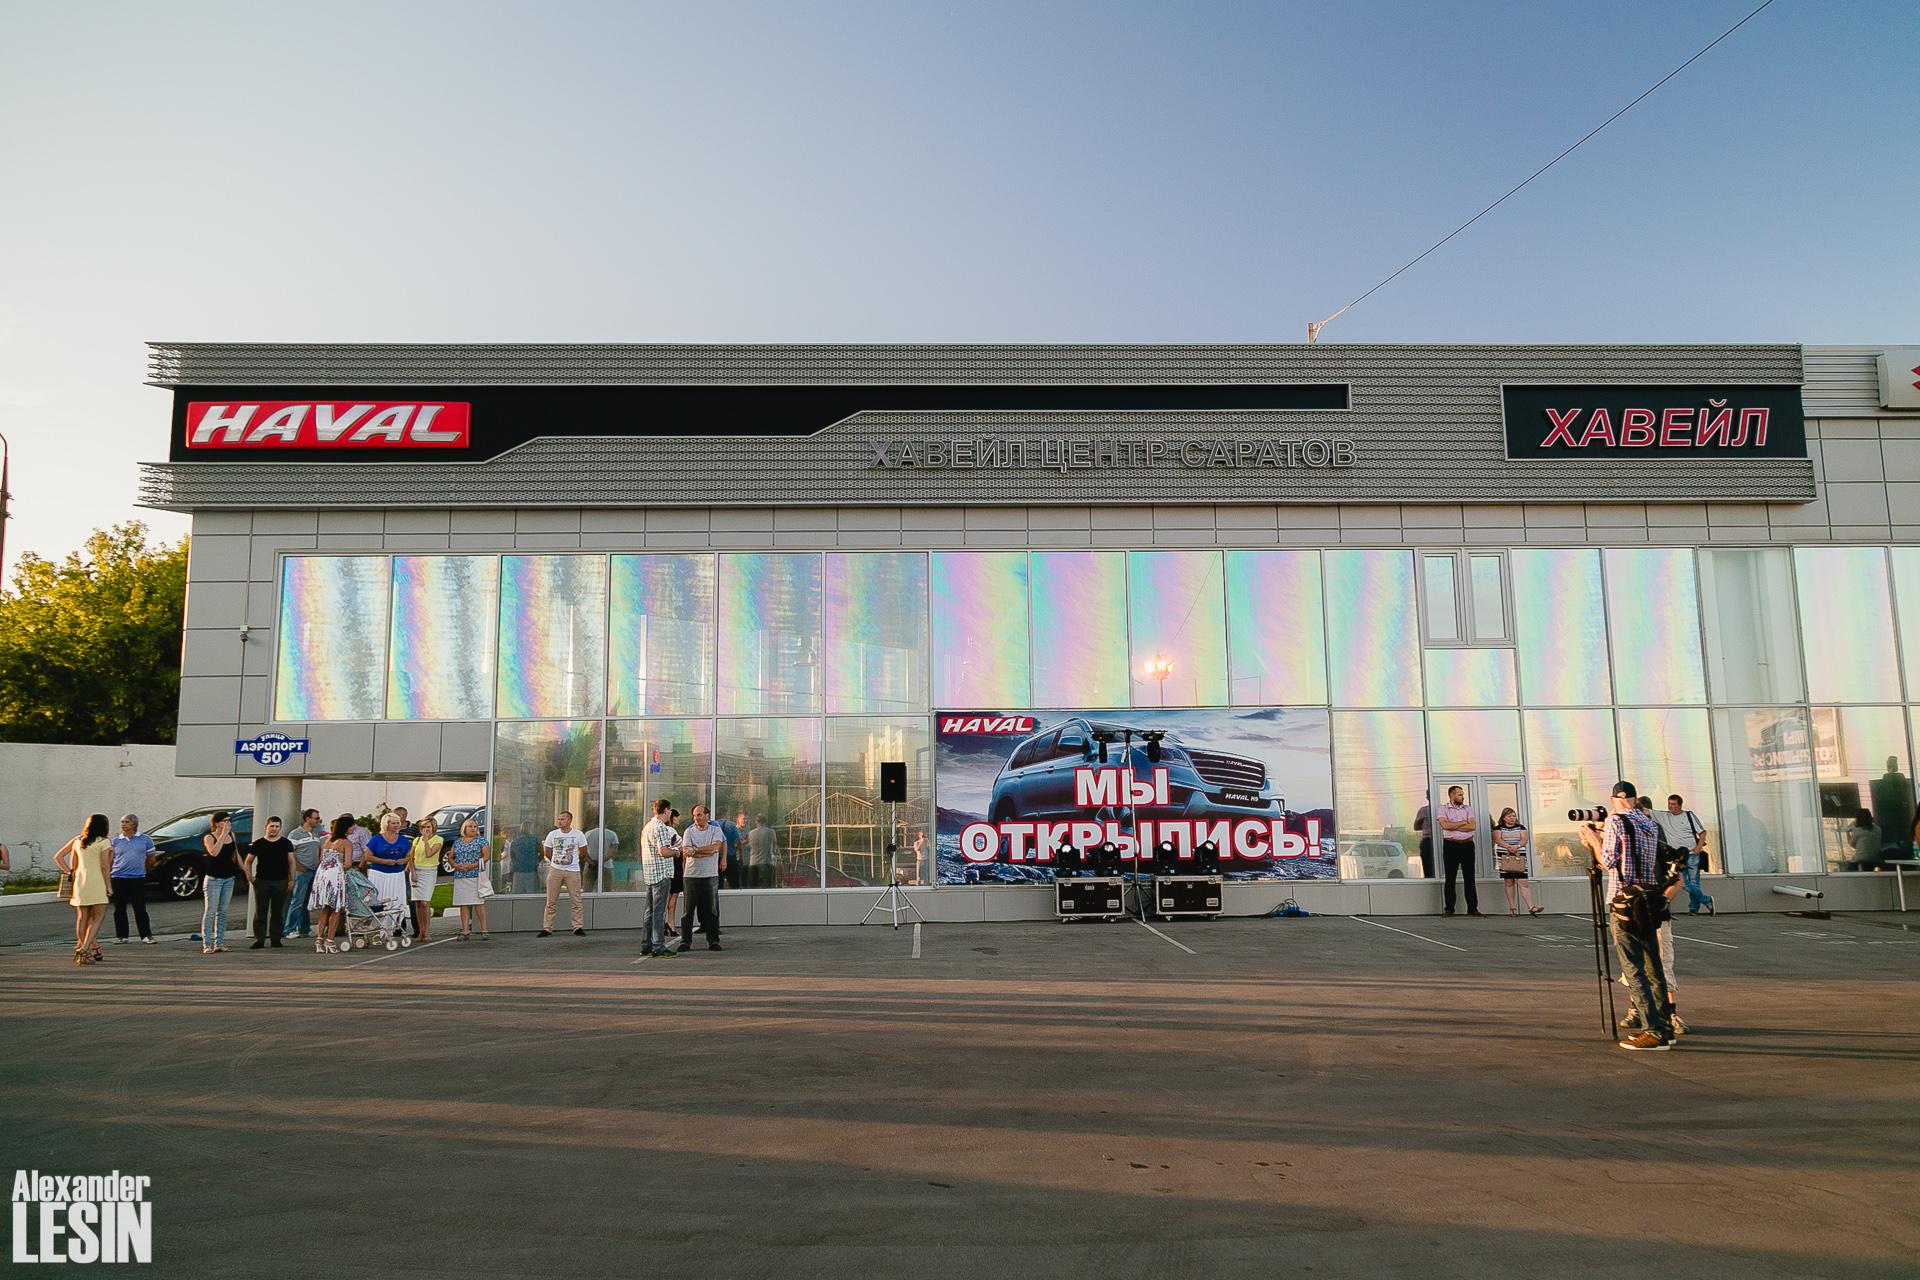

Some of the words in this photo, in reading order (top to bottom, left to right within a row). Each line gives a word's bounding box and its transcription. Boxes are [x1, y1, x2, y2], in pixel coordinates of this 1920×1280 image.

[191, 405, 462, 443] HAVAL
[1540, 398, 1770, 447] ХАВЕЙЛ
[868, 434, 1029, 468] ХАВЕЙЛ
[1040, 438, 1170, 472] ЦЕНТР
[1181, 439, 1358, 468] САРАТОВ
[942, 718, 1033, 733] HAVAL
[260, 733, 286, 742] улица
[240, 742, 304, 752] АЭРОПОРТ
[261, 752, 282, 764] 50
[1076, 768, 1168, 806] МЫ
[1225, 793, 1249, 801] HAVAL
